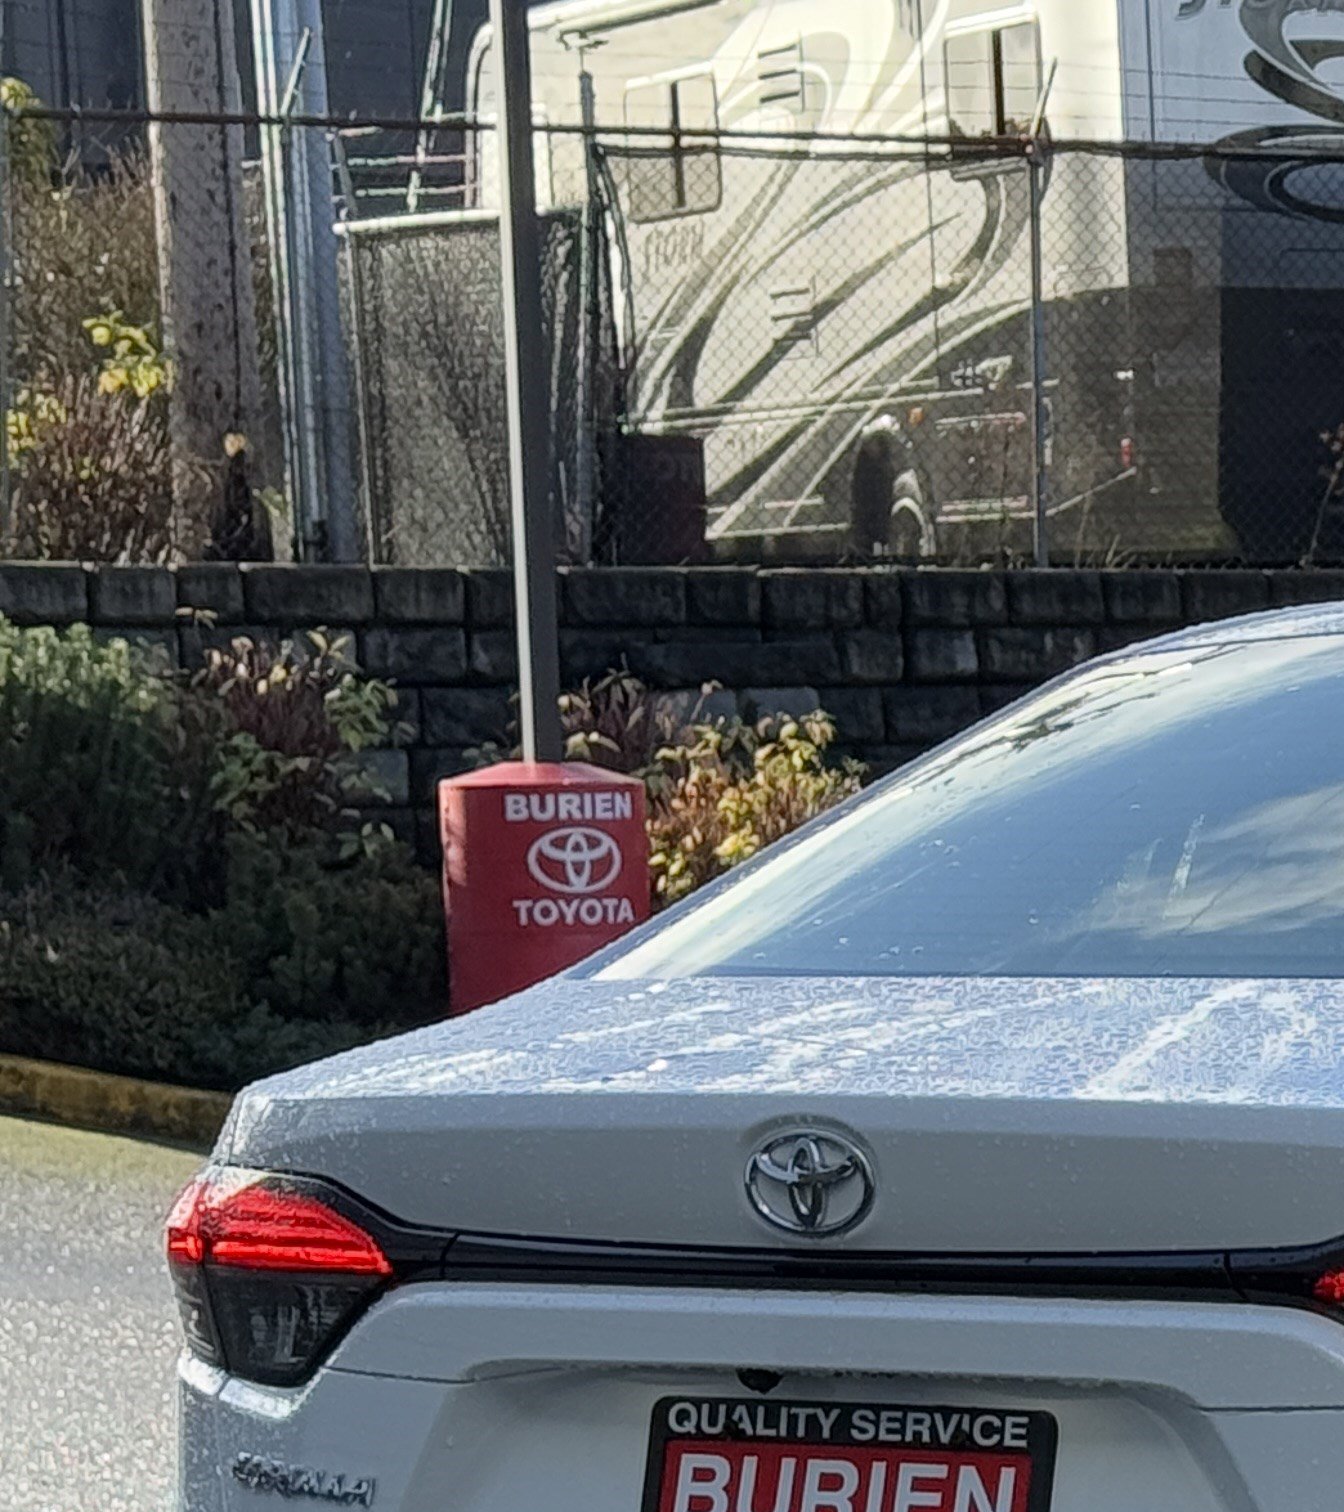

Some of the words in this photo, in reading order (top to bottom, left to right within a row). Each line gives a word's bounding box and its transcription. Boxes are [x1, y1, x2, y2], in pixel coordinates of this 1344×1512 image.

[504, 791, 633, 822] BURIEN
[512, 897, 635, 927] TOYOTA
[667, 1401, 841, 1441] QUALITY
[850, 1409, 1030, 1449] SERVICE
